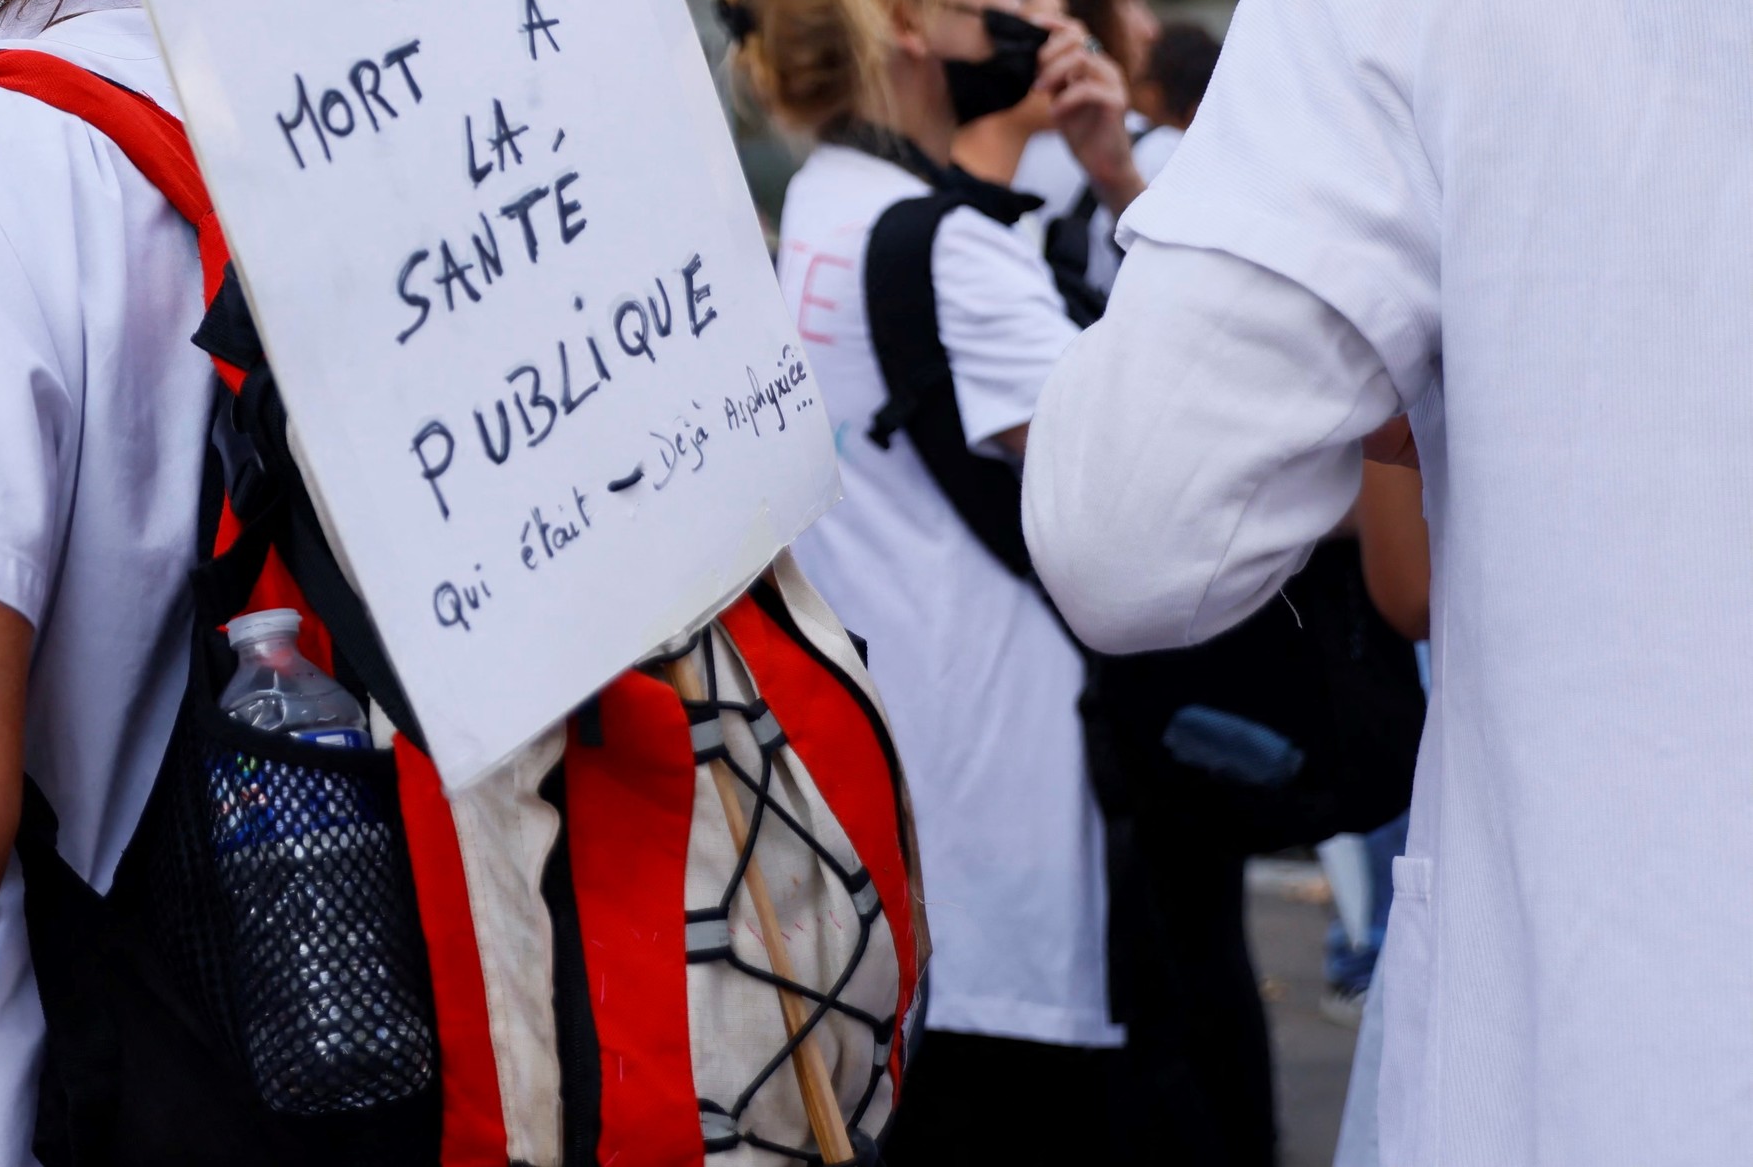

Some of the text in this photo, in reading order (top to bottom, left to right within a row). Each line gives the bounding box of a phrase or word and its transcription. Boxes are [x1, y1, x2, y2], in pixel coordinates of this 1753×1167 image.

[275, 38, 424, 171] MORT
[463, 97, 531, 190] LA
[395, 127, 589, 346] SANTÉ
[408, 251, 719, 522] PUBLIQUE
[432, 563, 492, 633] Qui
[519, 485, 593, 572] était
